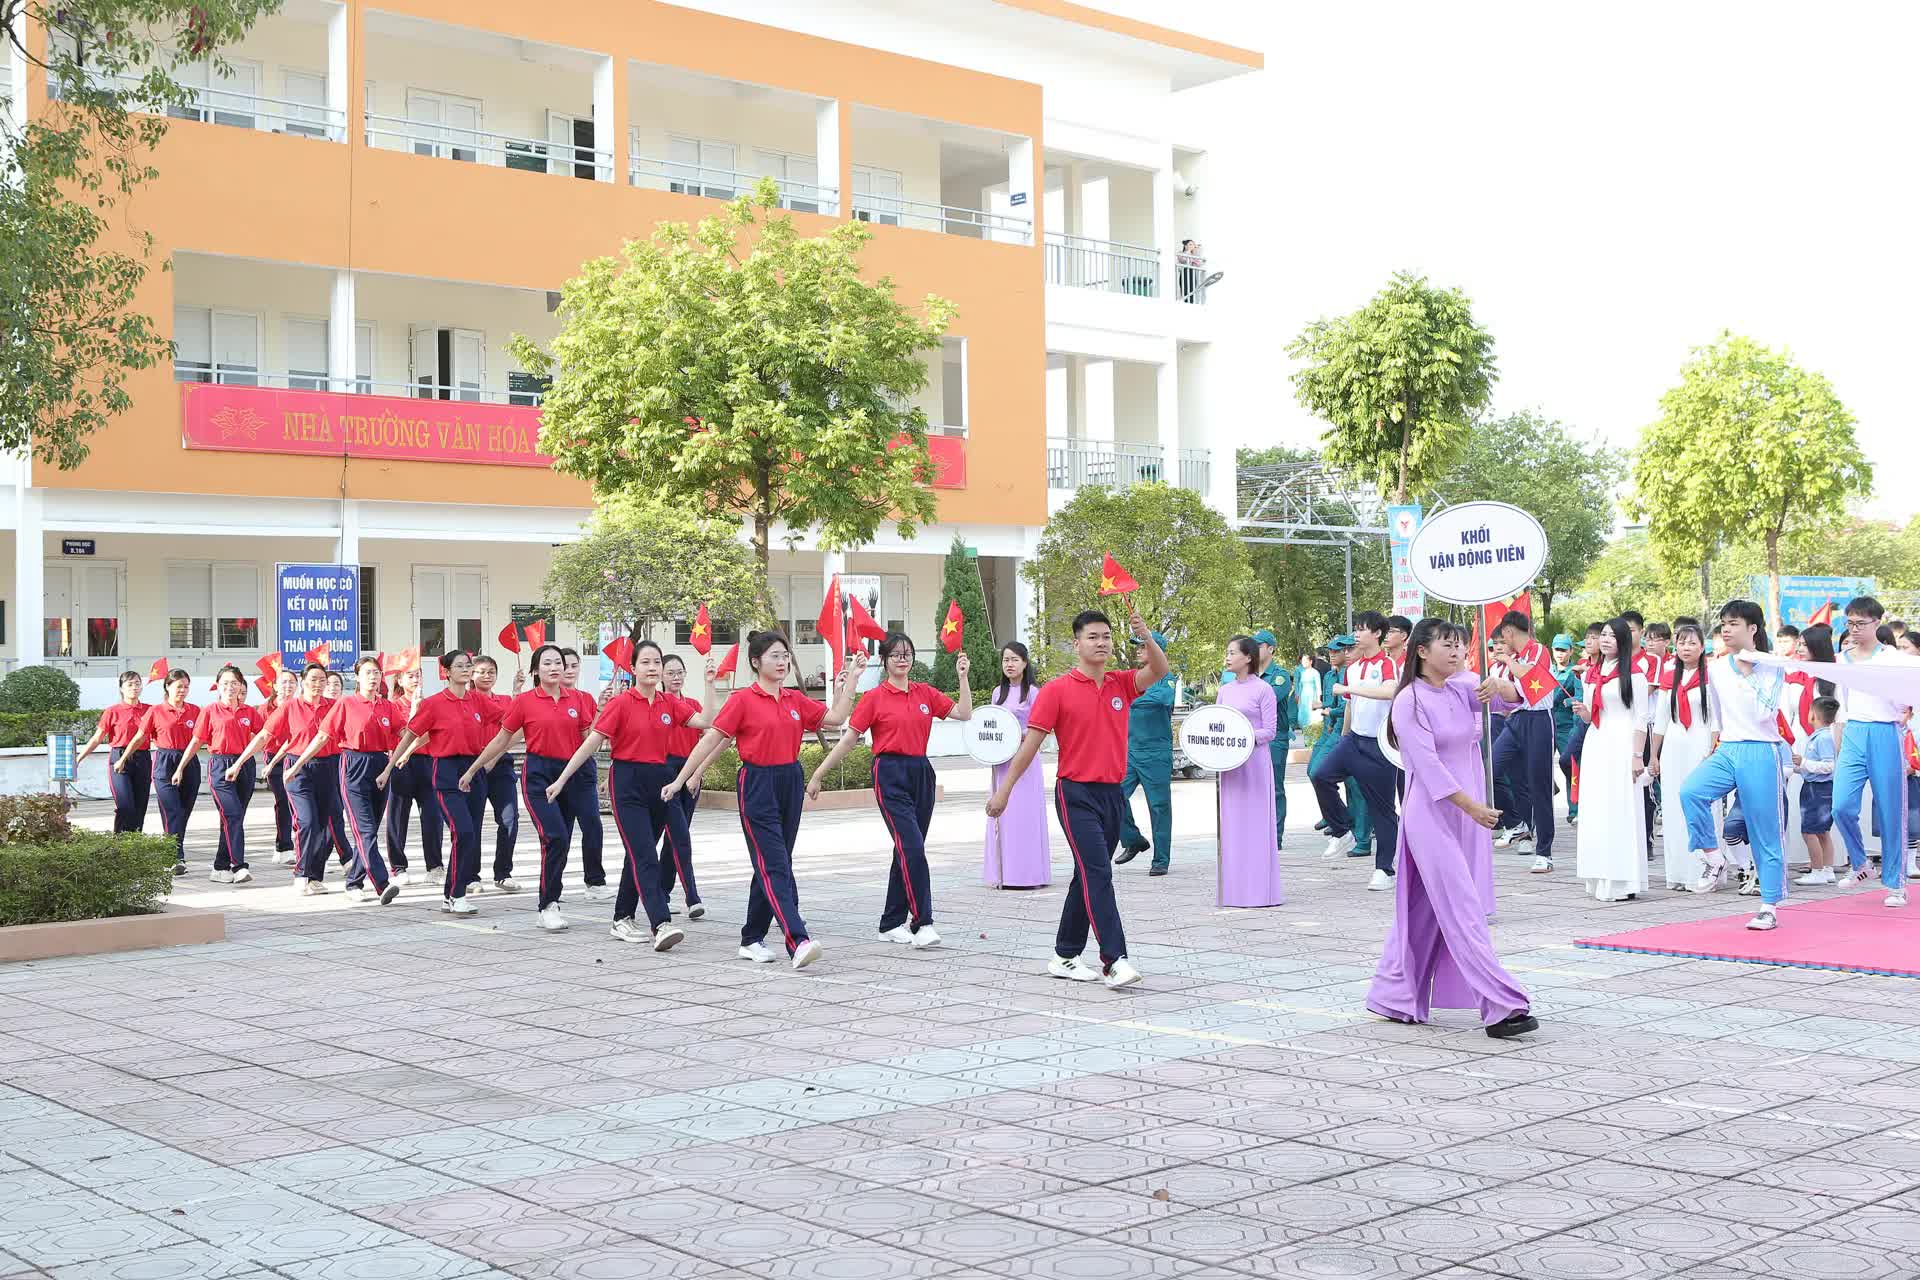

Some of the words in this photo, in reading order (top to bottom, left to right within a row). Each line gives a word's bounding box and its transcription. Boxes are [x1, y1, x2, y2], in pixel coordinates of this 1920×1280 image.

[281, 402, 335, 442] NHÀ
[339, 407, 431, 449] TRƯỜNG
[436, 416, 481, 450] VĂN
[488, 418, 531, 453] HÓA
[1461, 523, 1490, 545] KHỐI
[1430, 551, 1455, 572] VẬN
[1458, 548, 1492, 568] ĐỘNG
[1495, 544, 1525, 563] VIÊN
[283, 572, 314, 590] MUỐN
[316, 577, 337, 593] HỌC
[339, 575, 353, 590] CÓ
[287, 593, 306, 610] KẾT
[308, 593, 329, 612] QUẢ
[331, 594, 349, 610] TỐT
[288, 616, 306, 631] THÌ
[308, 615, 332, 631] PHẢI
[334, 616, 348, 631] CÓ
[284, 637, 307, 652] THÁI
[983, 718, 997, 729] KHỐI
[1208, 721, 1225, 733] KHỐI
[994, 731, 1004, 744] SỰ
[1187, 734, 1209, 746] TRUNG
[1210, 736, 1225, 748] HỌC
[1226, 737, 1236, 747] CƠ
[1237, 735, 1247, 748] SỞ
